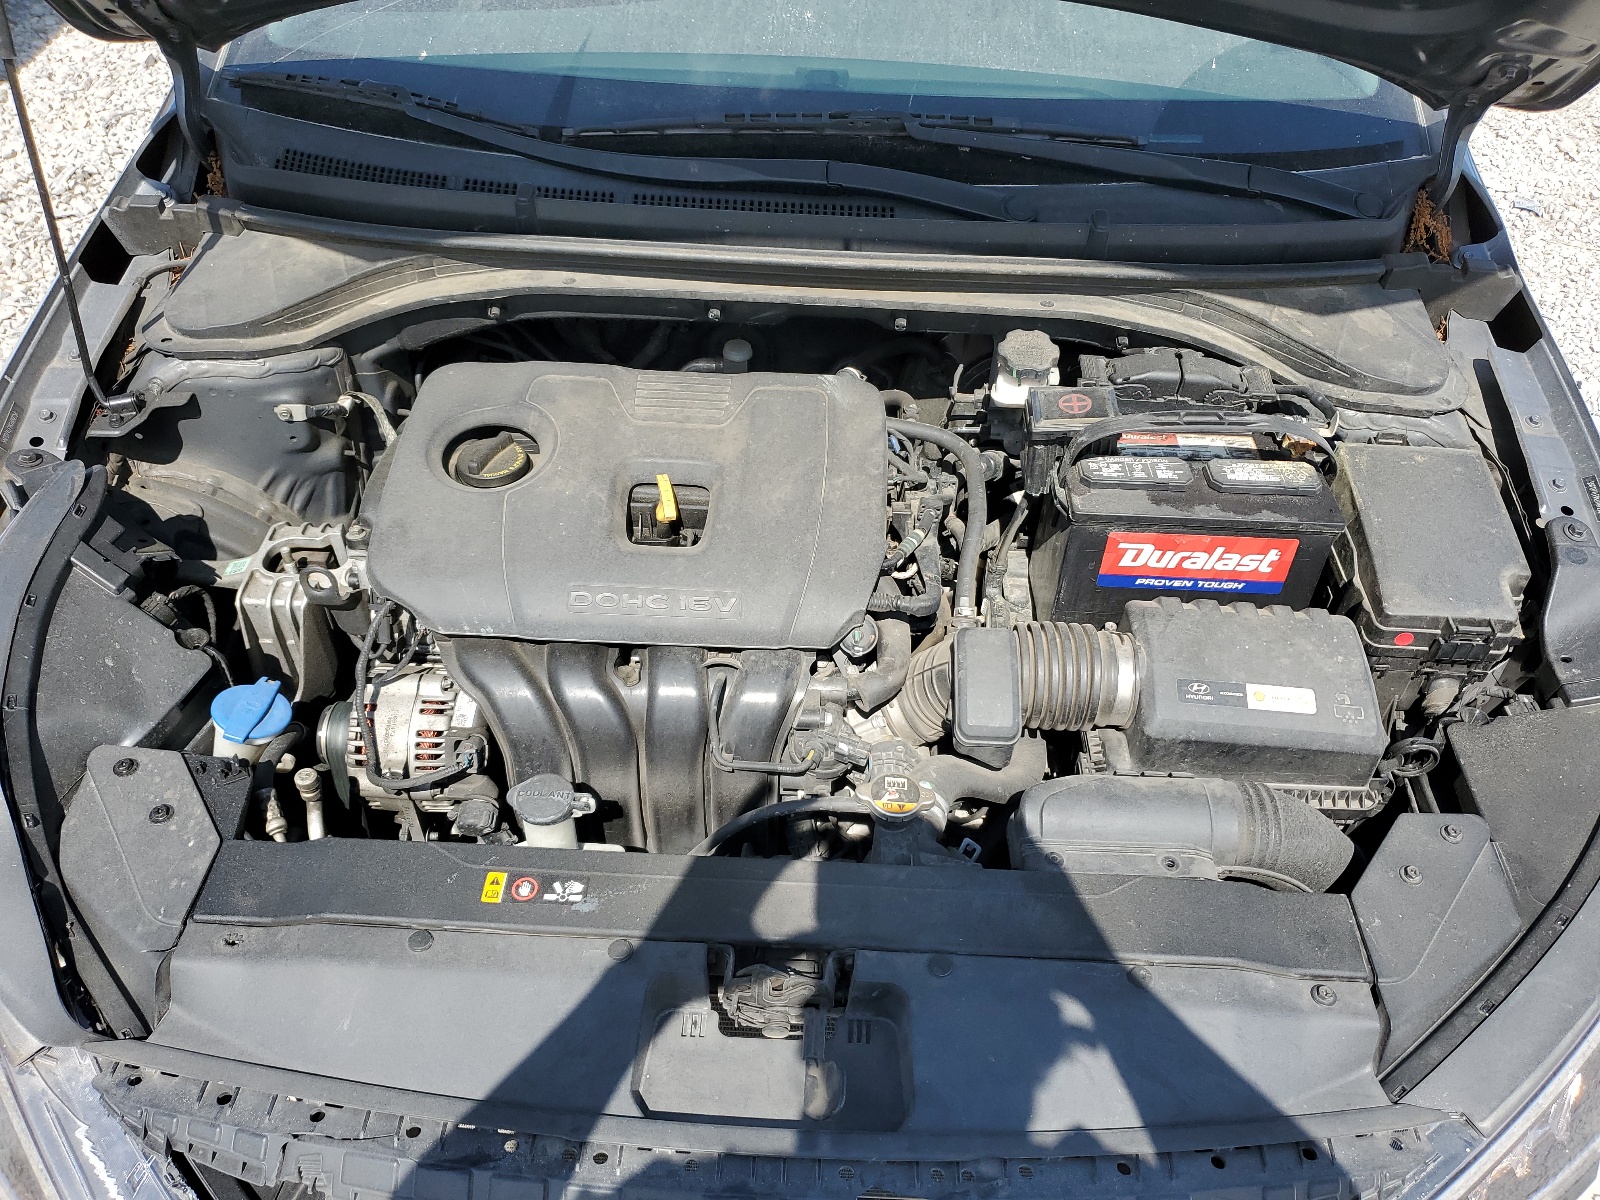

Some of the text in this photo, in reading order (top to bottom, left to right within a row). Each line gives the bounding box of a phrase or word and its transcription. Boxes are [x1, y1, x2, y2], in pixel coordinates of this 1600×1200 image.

[1117, 543, 1281, 573] Duralast
[1135, 578, 1246, 589] PROVEN TOUGH
[570, 591, 738, 613] DOHC 16V
[517, 789, 571, 800] COOLANT
